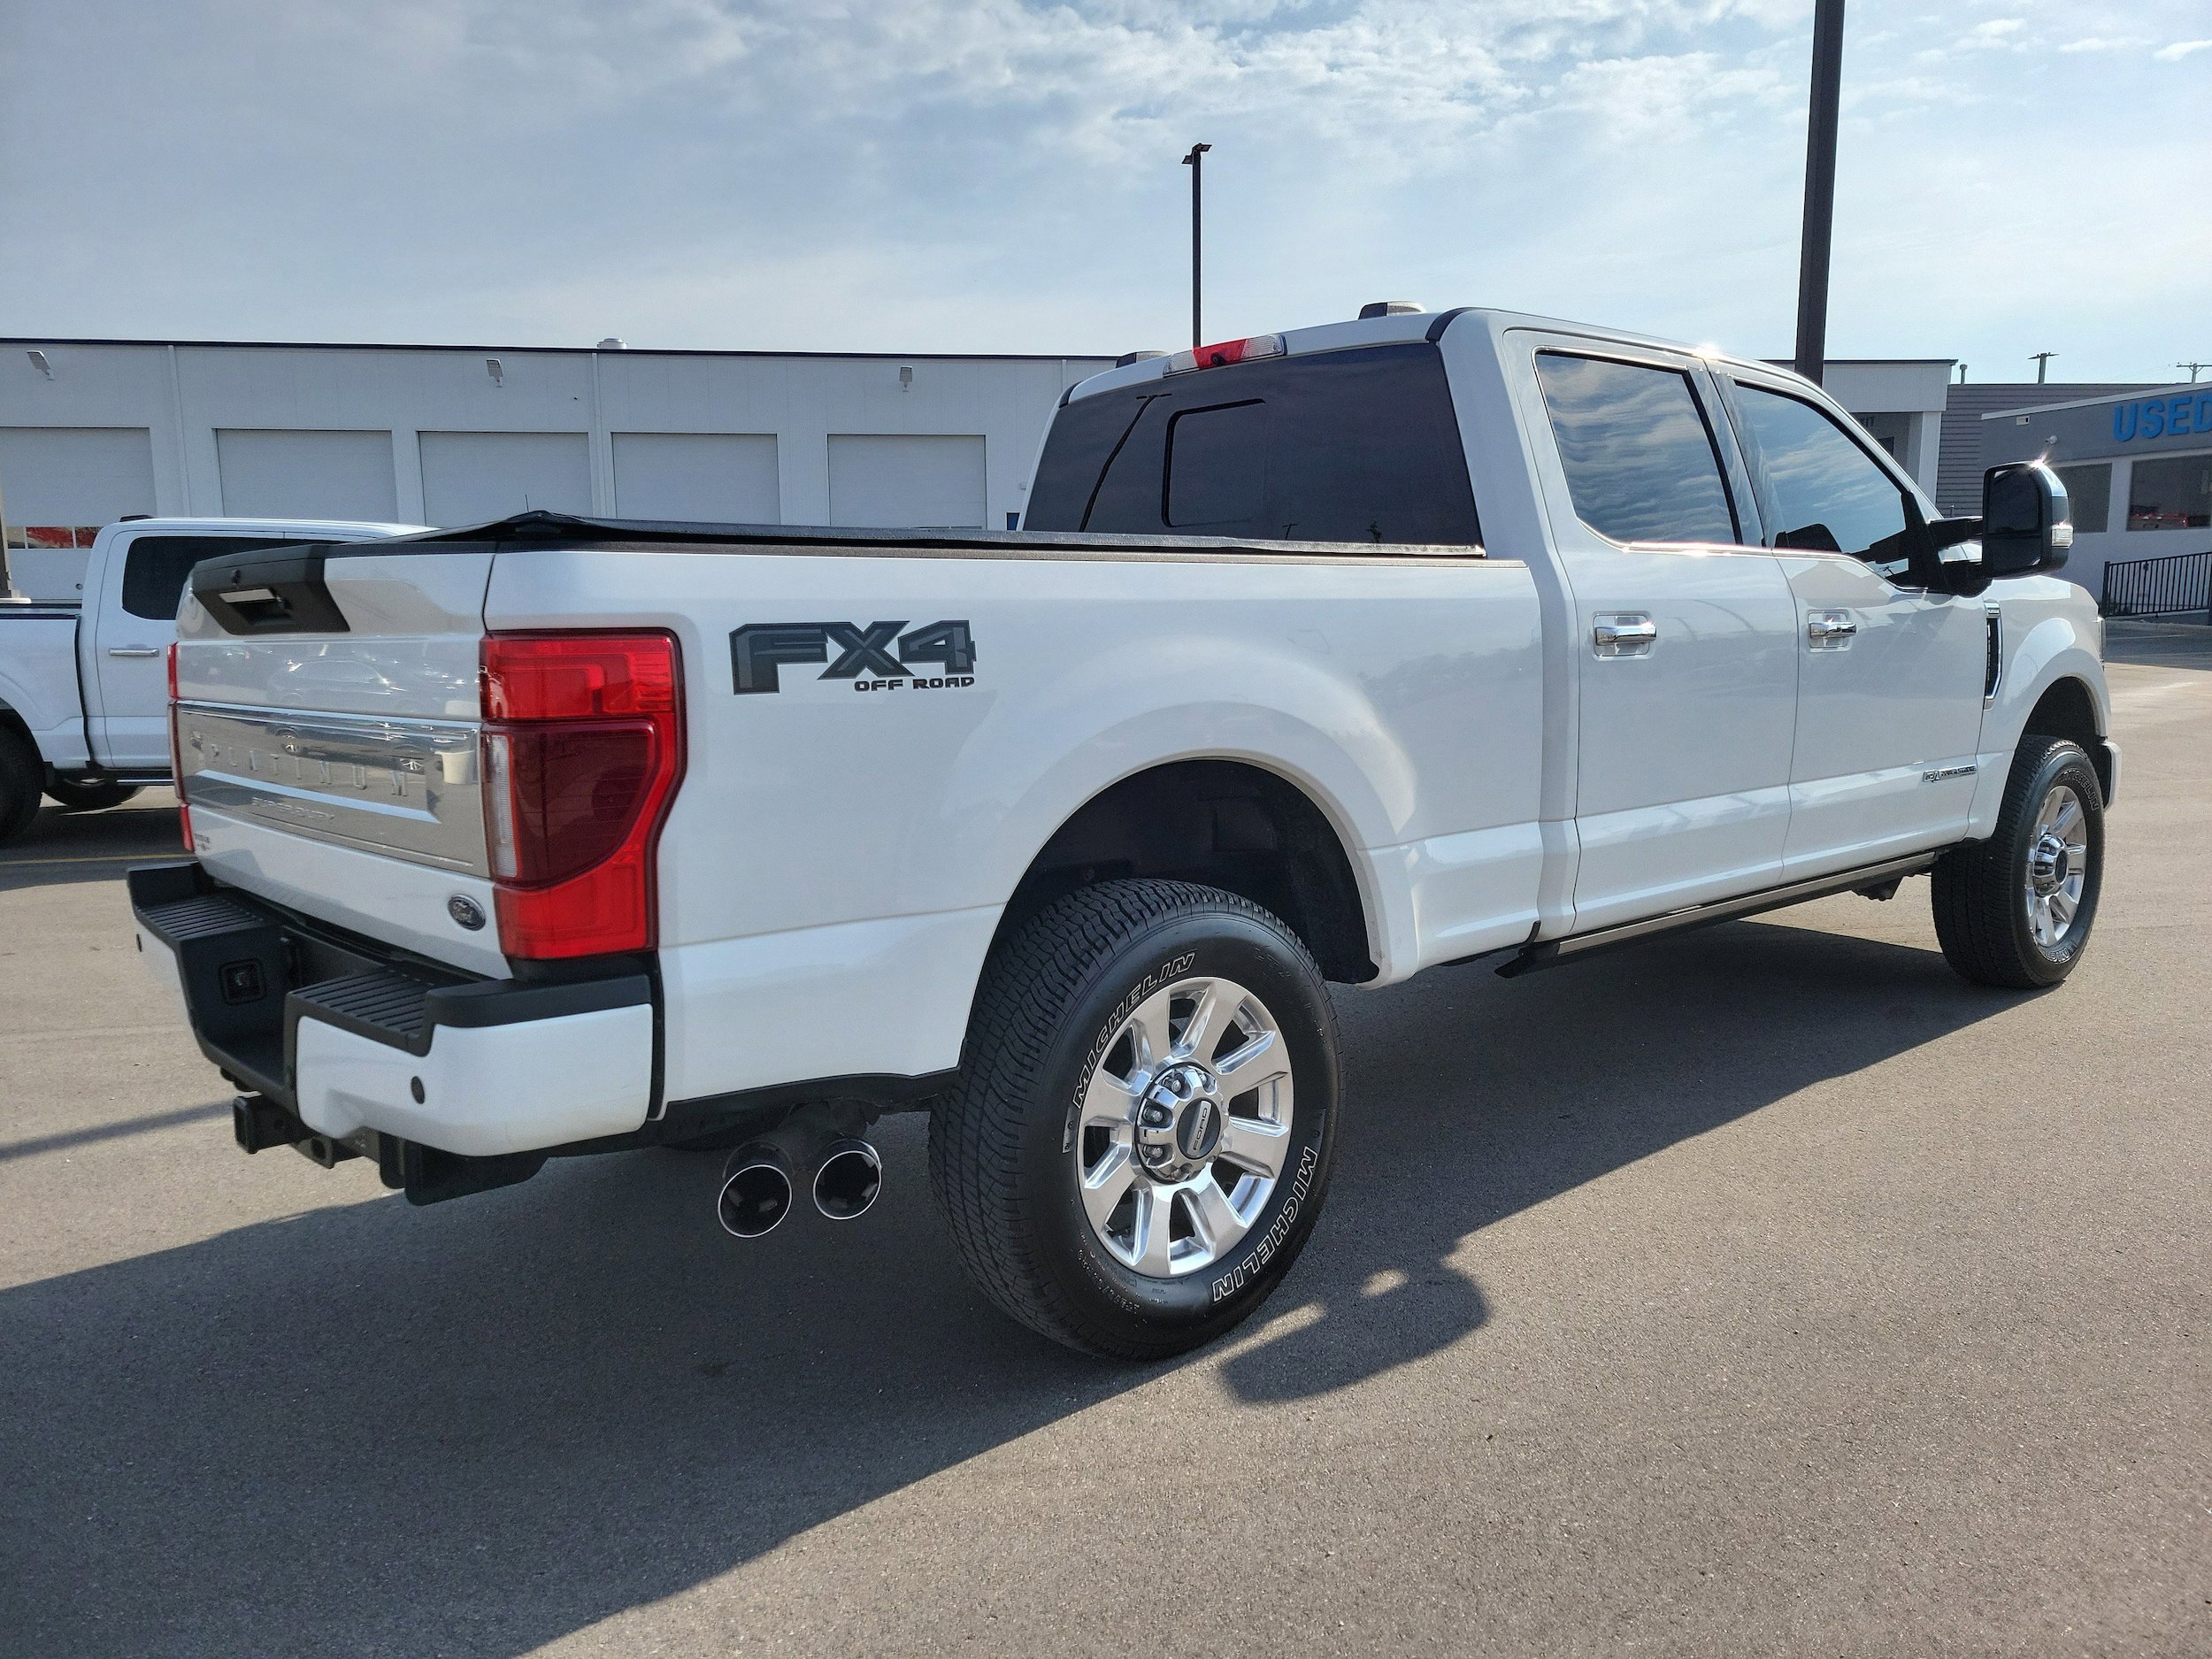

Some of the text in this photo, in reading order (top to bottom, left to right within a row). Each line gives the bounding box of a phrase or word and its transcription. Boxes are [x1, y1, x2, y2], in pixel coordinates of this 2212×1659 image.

[2113, 393, 2212, 442] USED
[728, 619, 977, 695] FX4
[854, 676, 975, 692] OFF ROAD
[1072, 952, 1195, 1109] MICHELIN
[1193, 1107, 1208, 1150] FORD
[1211, 1146, 1318, 1302] MICHELIN
